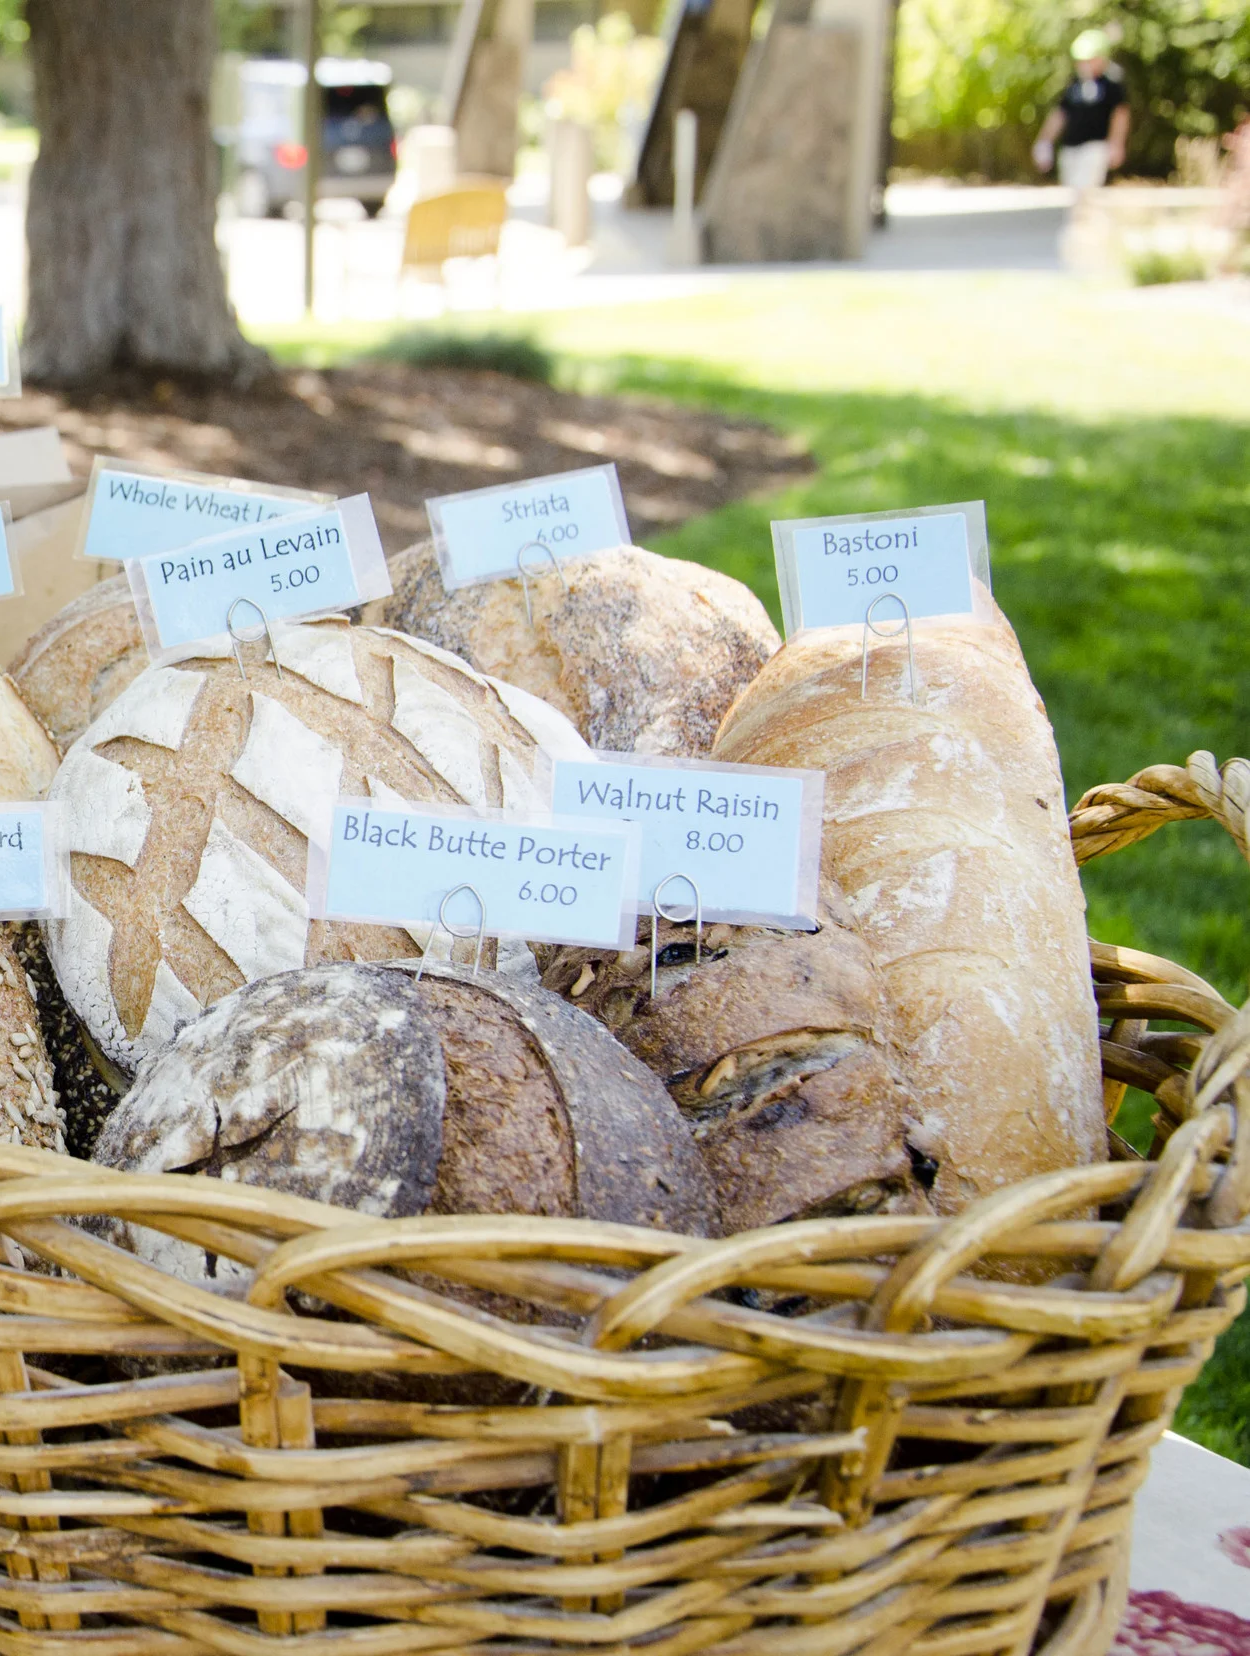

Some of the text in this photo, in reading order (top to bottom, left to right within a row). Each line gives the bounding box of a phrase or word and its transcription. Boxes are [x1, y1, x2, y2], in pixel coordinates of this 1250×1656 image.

[109, 479, 177, 510] Whole
[184, 492, 250, 523] Wheat
[501, 492, 570, 523] Striata
[536, 522, 579, 544] 6.00
[822, 525, 919, 556] Bastoni
[160, 525, 341, 585] Pain au Levain
[270, 564, 320, 593] 5.00
[847, 564, 899, 587] 5.00
[578, 778, 779, 821] Walnut Raisin
[342, 812, 612, 872] Black Butte Porter
[686, 830, 744, 853] 8.00
[518, 880, 578, 906] 6.00
